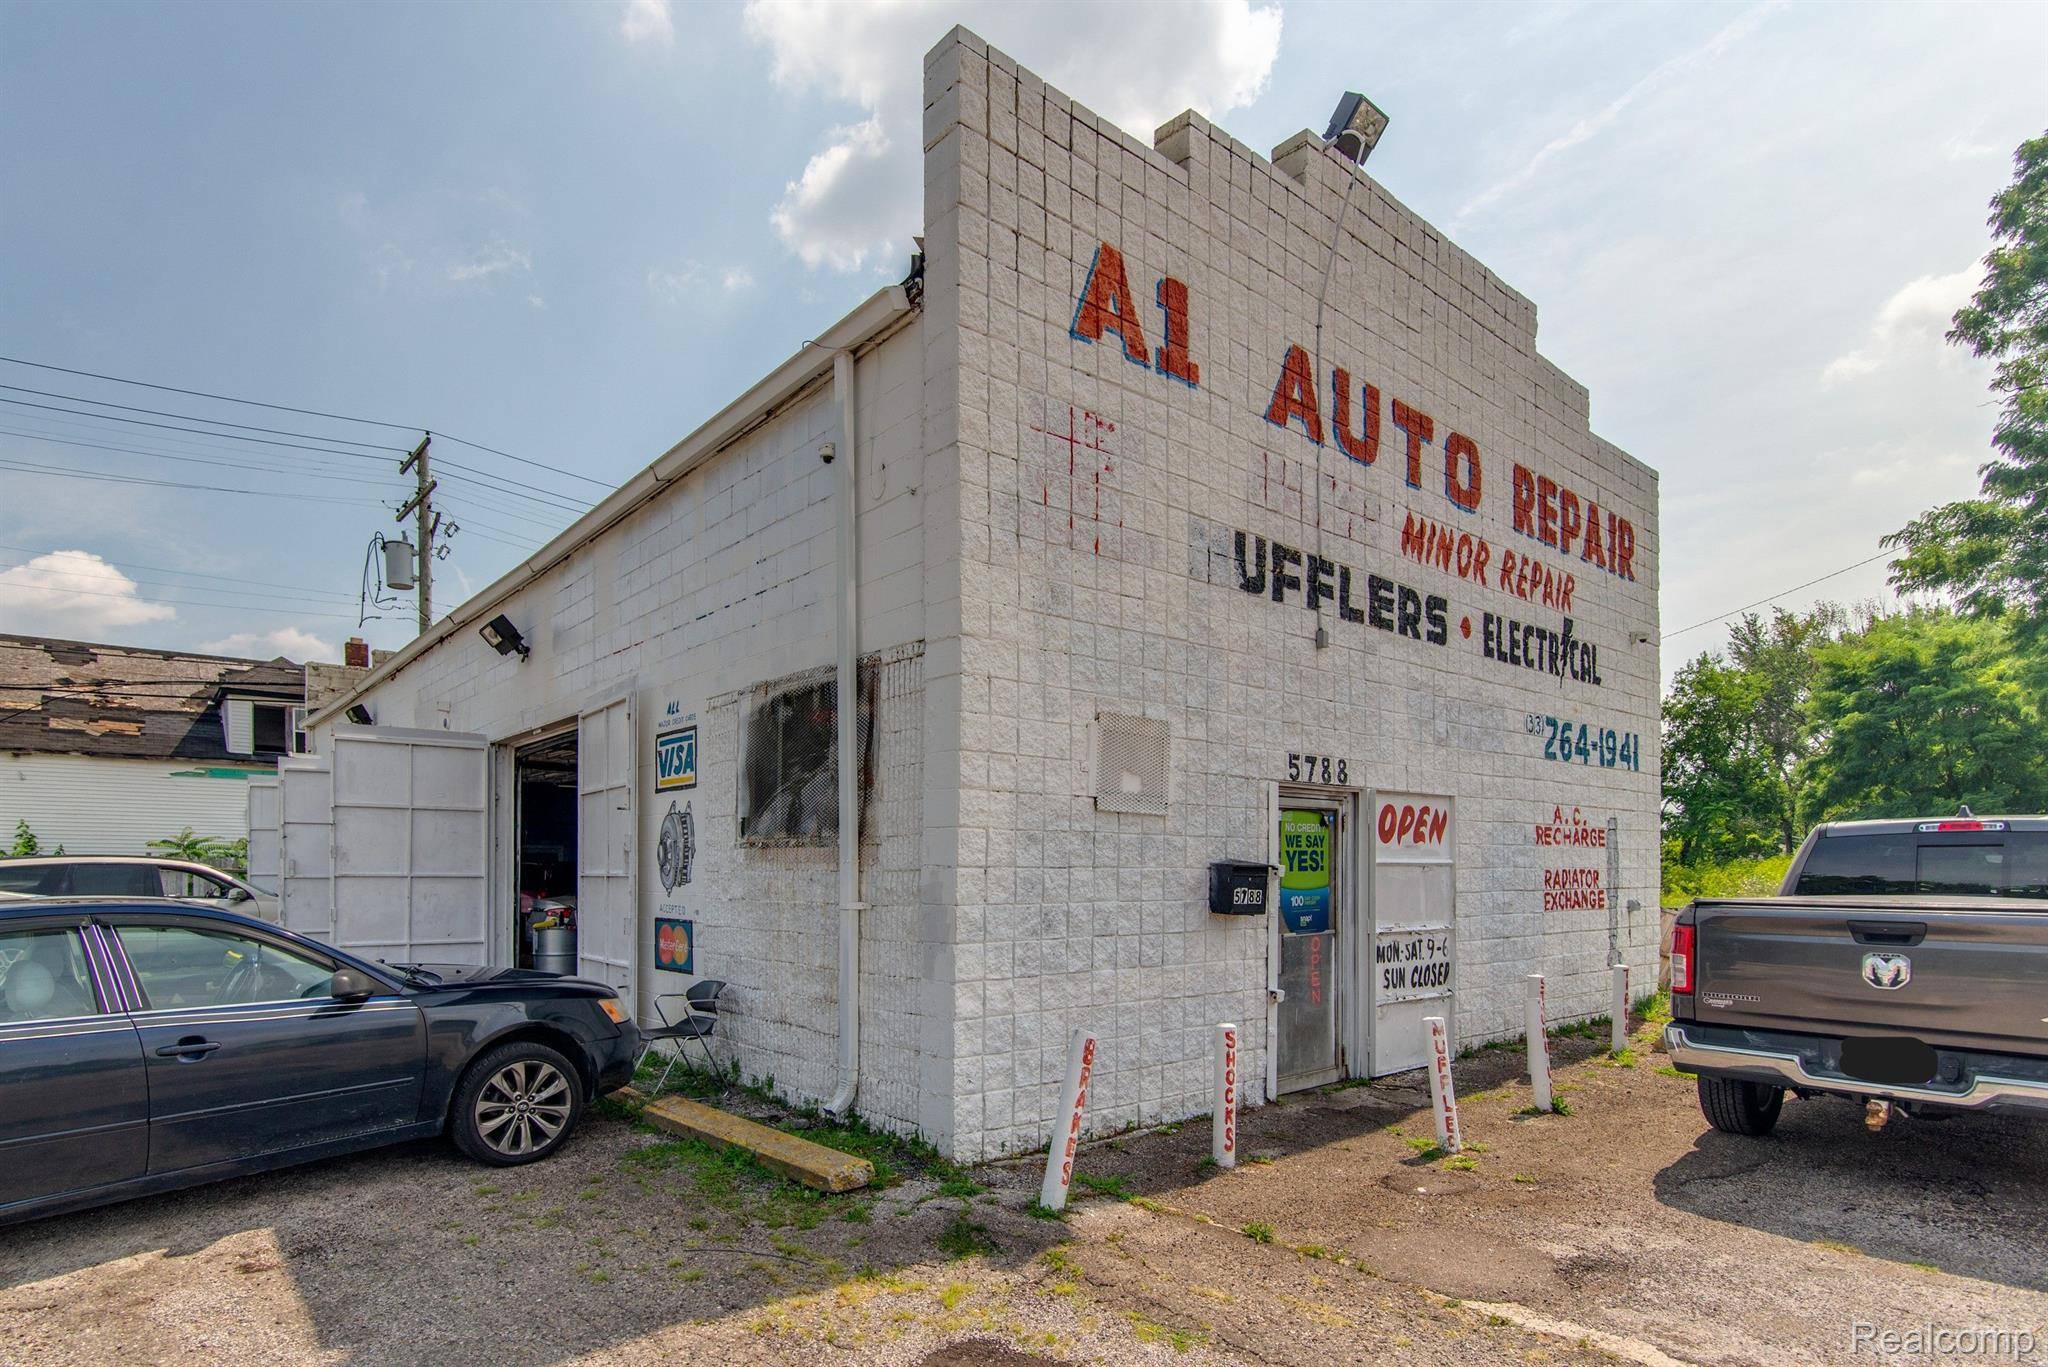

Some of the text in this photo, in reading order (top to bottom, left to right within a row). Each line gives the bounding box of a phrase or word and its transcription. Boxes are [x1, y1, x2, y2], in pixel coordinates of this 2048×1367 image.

[1069, 240, 1200, 390] A1
[1263, 343, 1482, 515] AUTO
[1512, 463, 1636, 582] REPAIR
[1401, 510, 1576, 614] MINOR REPAIR
[1234, 530, 1601, 688] UFFLERS ELECTRICAL
[666, 700, 680, 716] ALL
[1544, 714, 1640, 772] 264-1941
[658, 742, 694, 779] VISA
[1288, 752, 1348, 785] 5788
[1285, 822, 1296, 833] NO
[1378, 803, 1448, 846] OPEN
[1536, 825, 1605, 847] RECHARGE
[1285, 834, 1325, 849] WE SAY
[1285, 850, 1325, 873] YES!
[1544, 869, 1599, 889] RADIATOR
[1233, 889, 1262, 905] 5788
[1290, 895, 1304, 907] 100
[1543, 889, 1605, 912] EXCHANGE
[1383, 961, 1450, 990] SUN CLOSED
[1223, 1030, 1237, 1153] SHOCKS
[1061, 1038, 1096, 1187] BRAKES
